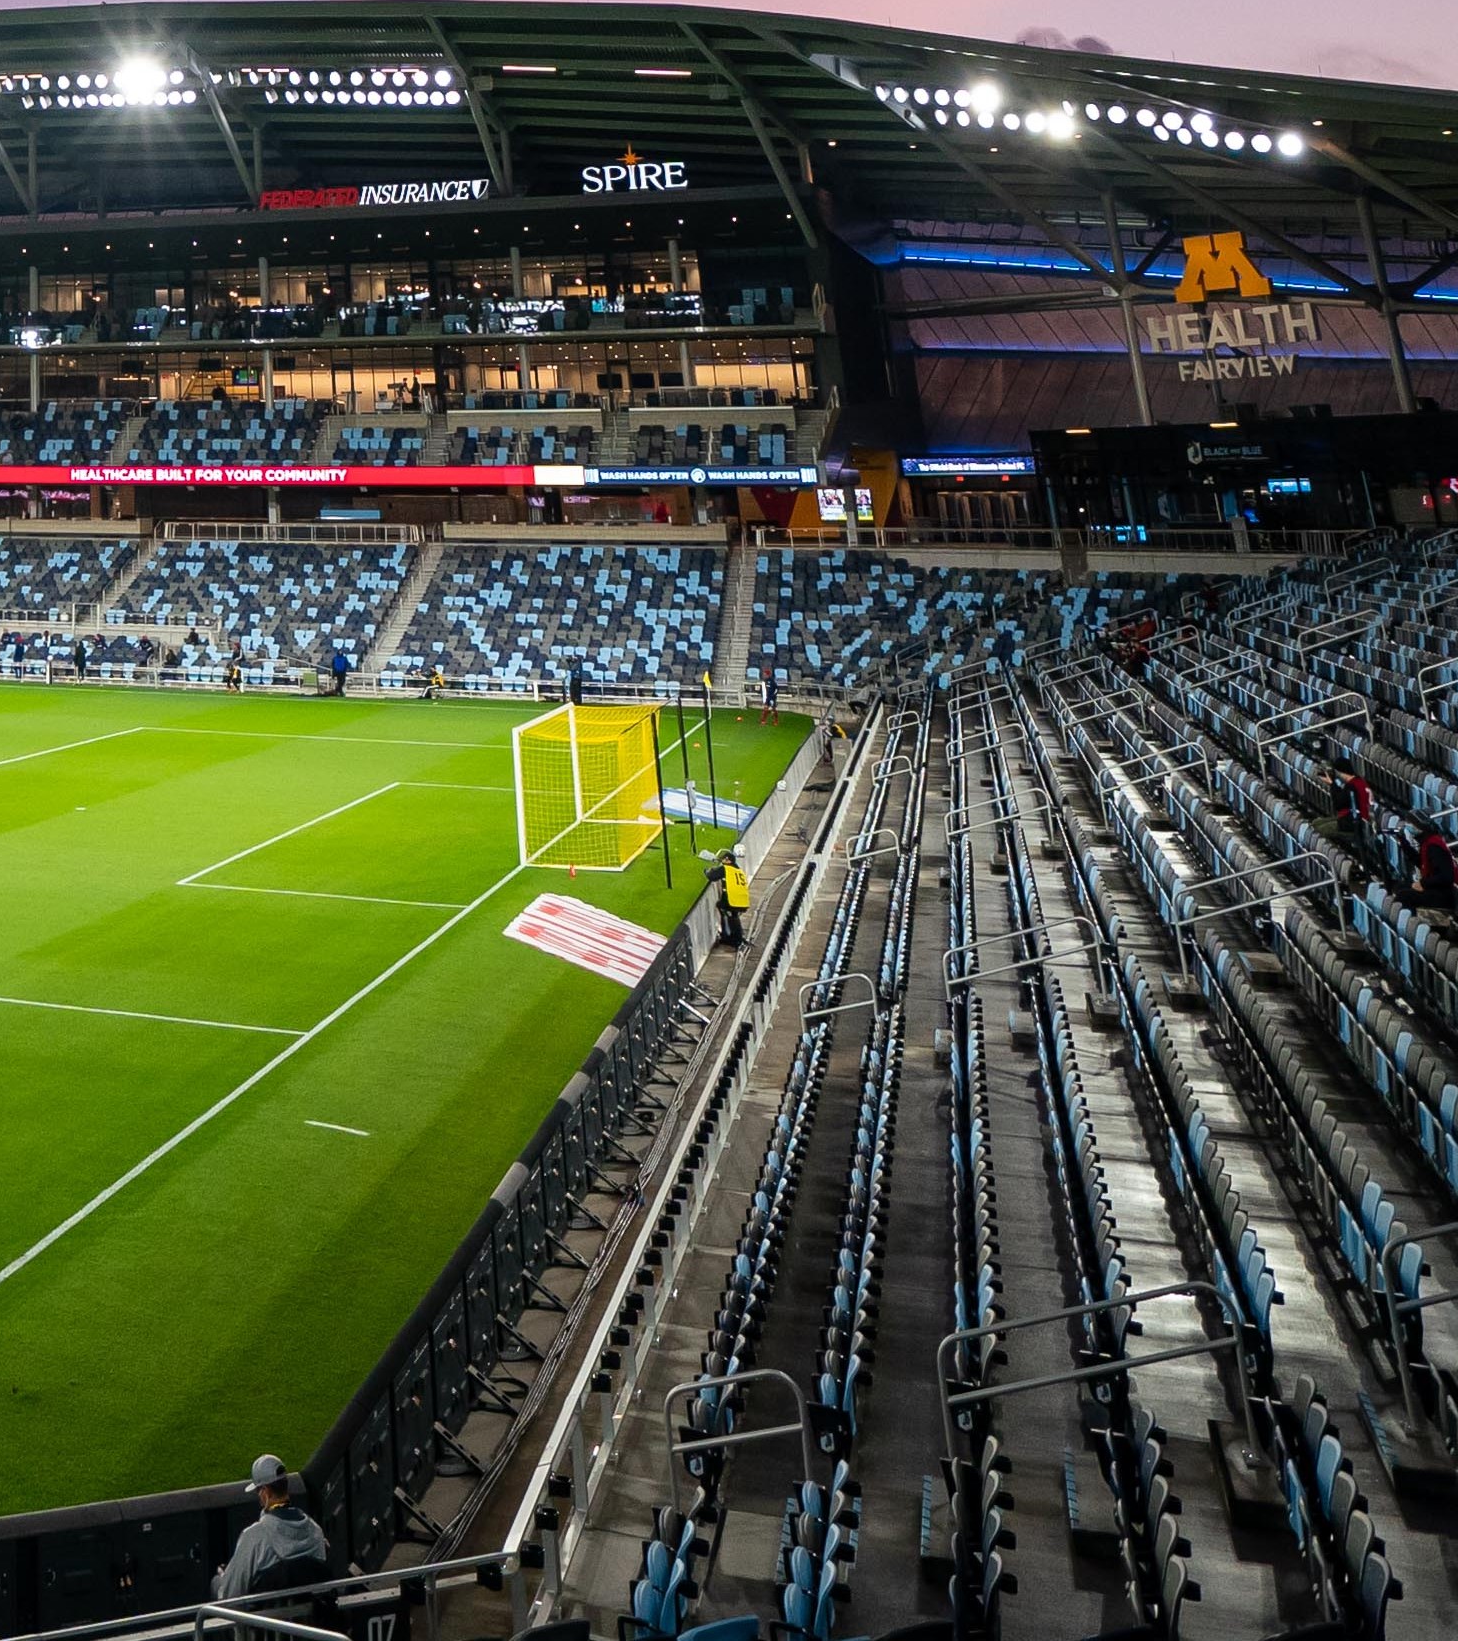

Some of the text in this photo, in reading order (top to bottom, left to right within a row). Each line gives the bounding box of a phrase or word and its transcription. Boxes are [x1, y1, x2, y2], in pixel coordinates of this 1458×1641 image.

[581, 162, 689, 194] SPIRE
[259, 180, 470, 210] FEDERATED INSURANCE
[1147, 302, 1318, 354] HEALTH
[1178, 354, 1296, 382] FAIRVIEW
[71, 468, 347, 482] HEALTHCARE BUILT FOR YOUR COMMUNITY
[600, 471, 627, 480] WASH
[628, 471, 658, 480] HANDS
[709, 471, 735, 480] WASH
[736, 471, 768, 480] HANDS
[769, 471, 801, 480] OFTEN
